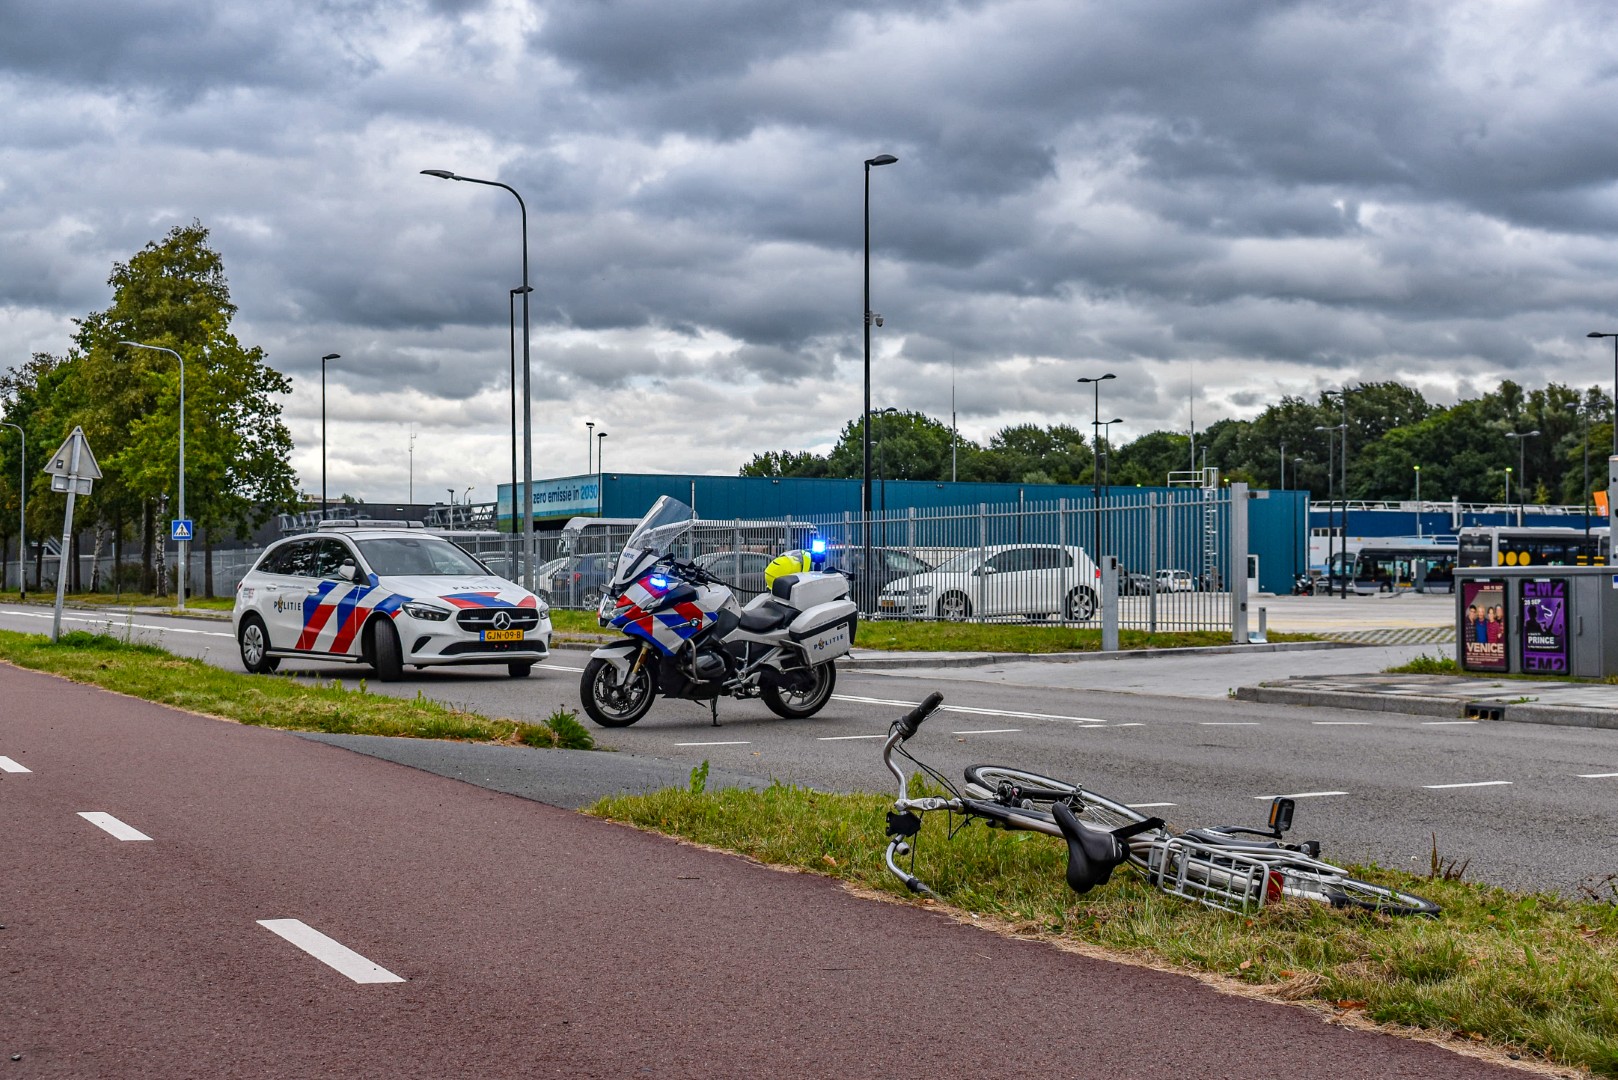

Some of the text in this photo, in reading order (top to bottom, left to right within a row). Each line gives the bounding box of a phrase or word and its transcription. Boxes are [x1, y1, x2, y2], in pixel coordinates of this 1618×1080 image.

[533, 484, 598, 504] zero emissie in 2030
[274, 600, 301, 613] POLITIE
[486, 631, 521, 640] GJN-09-B
[1528, 636, 1555, 644] PRINCE
[813, 634, 844, 650] POLITIE
[1466, 642, 1504, 653] VENICE
